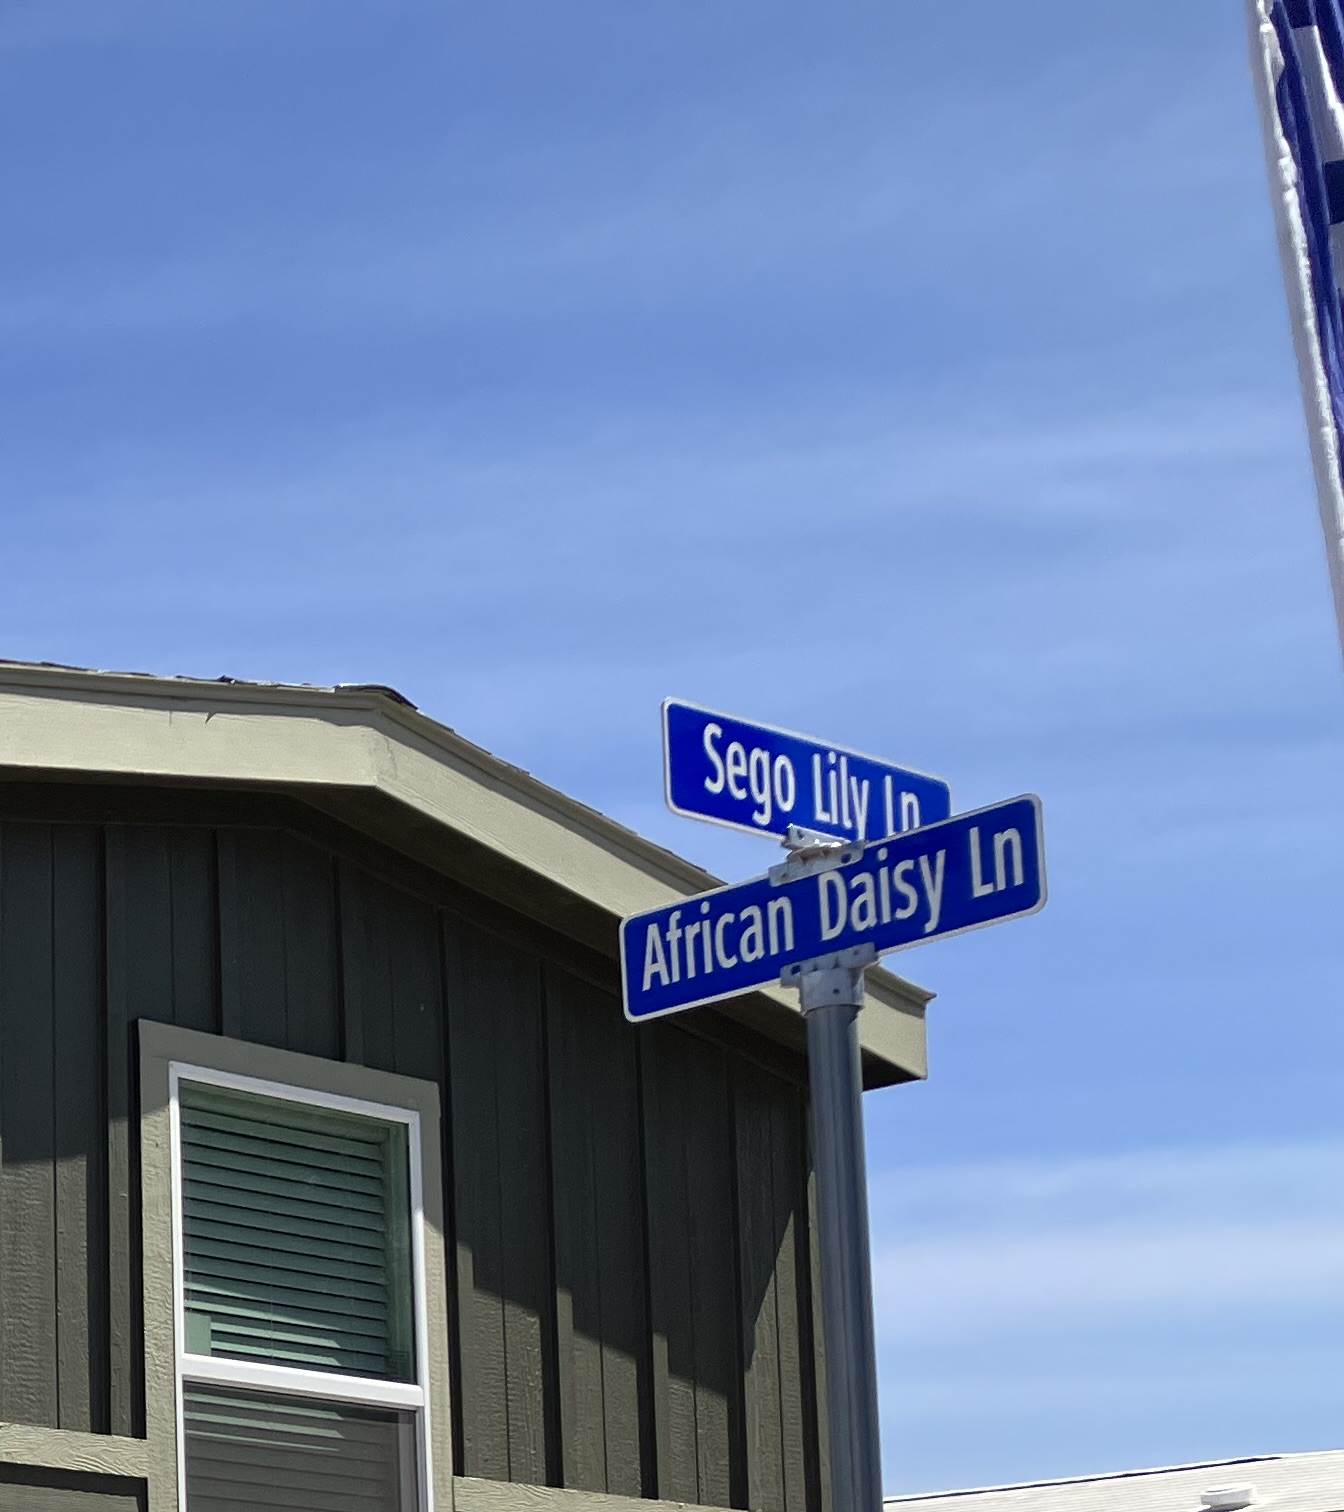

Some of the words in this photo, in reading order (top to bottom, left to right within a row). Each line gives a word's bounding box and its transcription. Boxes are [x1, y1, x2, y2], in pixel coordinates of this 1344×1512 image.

[703, 723, 796, 826] Sego
[812, 750, 870, 841] Lily
[885, 775, 920, 837] Ln
[642, 900, 795, 992] African
[818, 847, 946, 941] Daisy
[969, 826, 1024, 898] Ln
